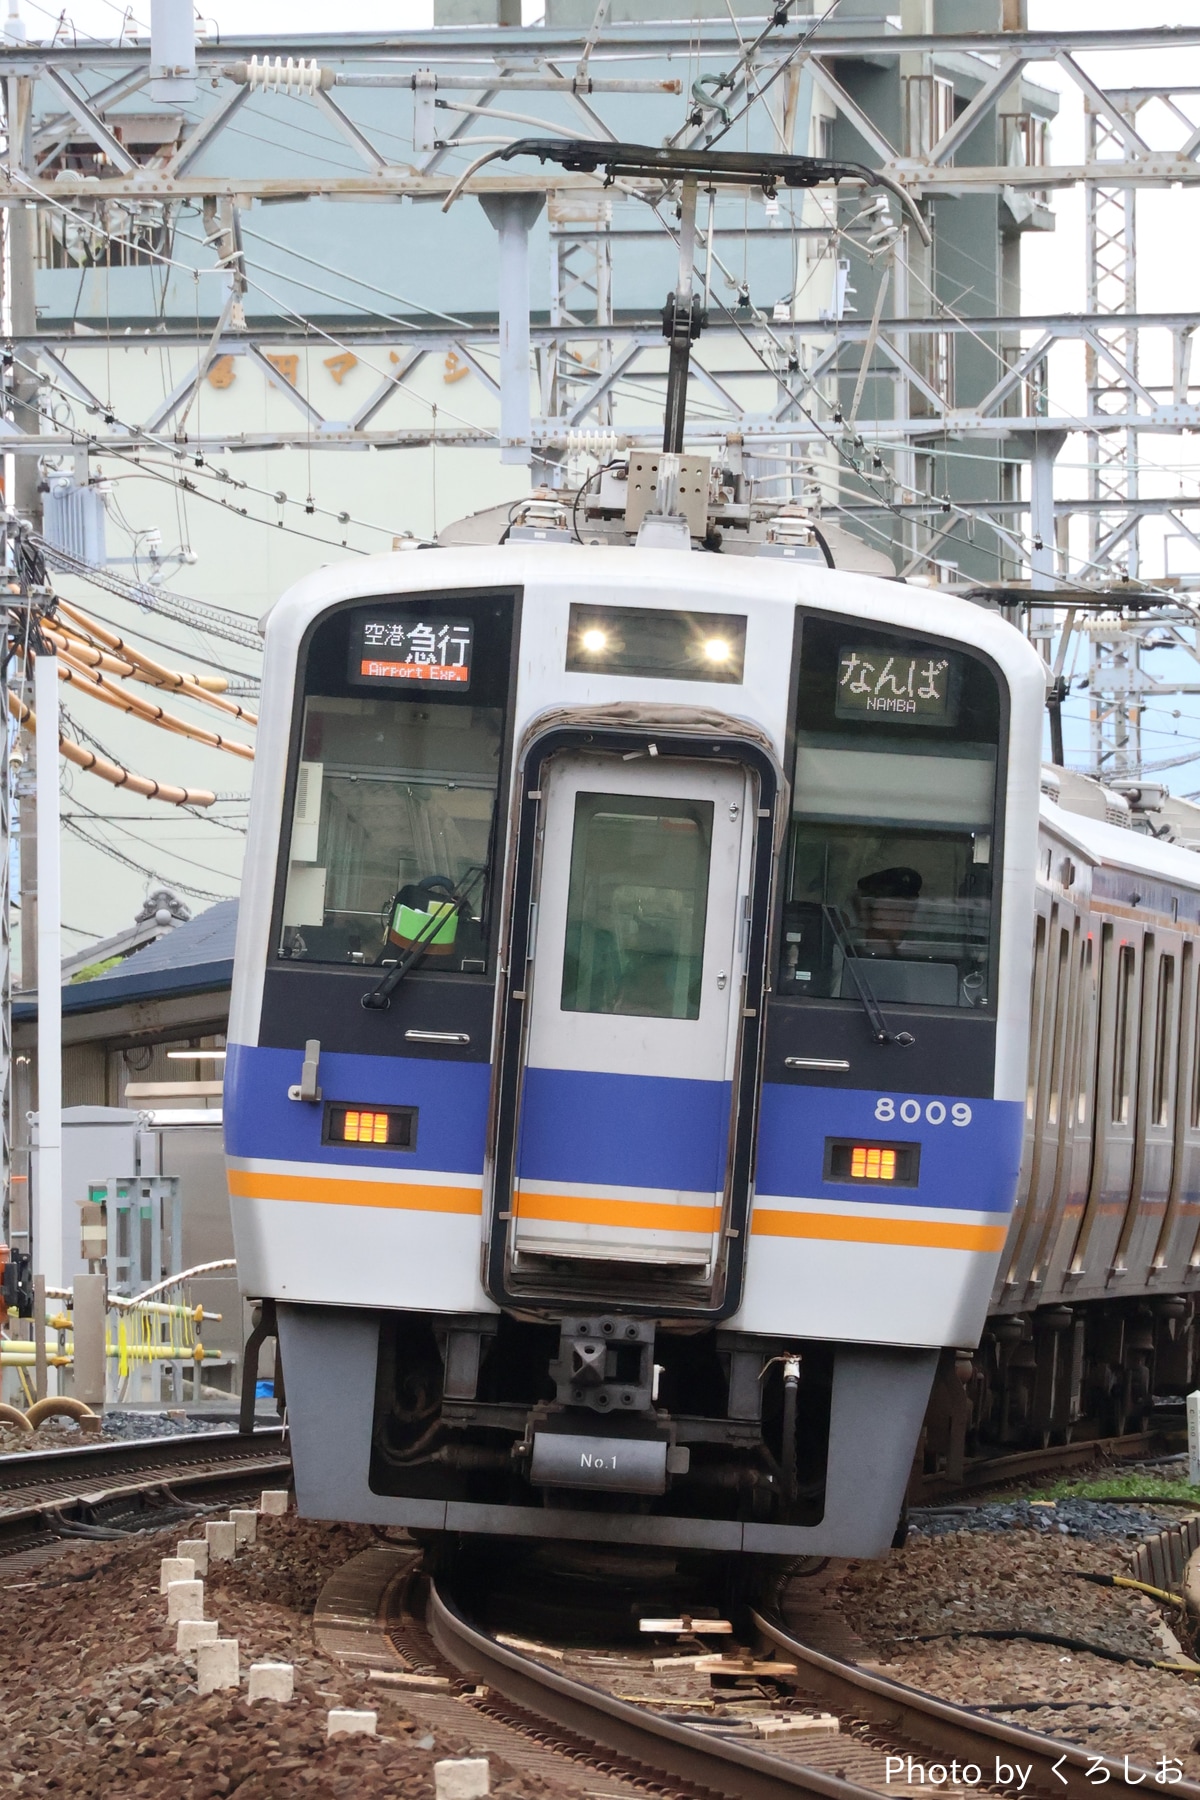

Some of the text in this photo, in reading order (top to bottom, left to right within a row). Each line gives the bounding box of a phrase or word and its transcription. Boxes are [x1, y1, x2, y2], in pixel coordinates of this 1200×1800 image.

[364, 623, 470, 667] 空港急行
[369, 662, 423, 679] Airport
[840, 653, 949, 699] なんば
[866, 697, 917, 713] NAMBA
[874, 1097, 972, 1127] 8009
[580, 1453, 617, 1470] No.1
